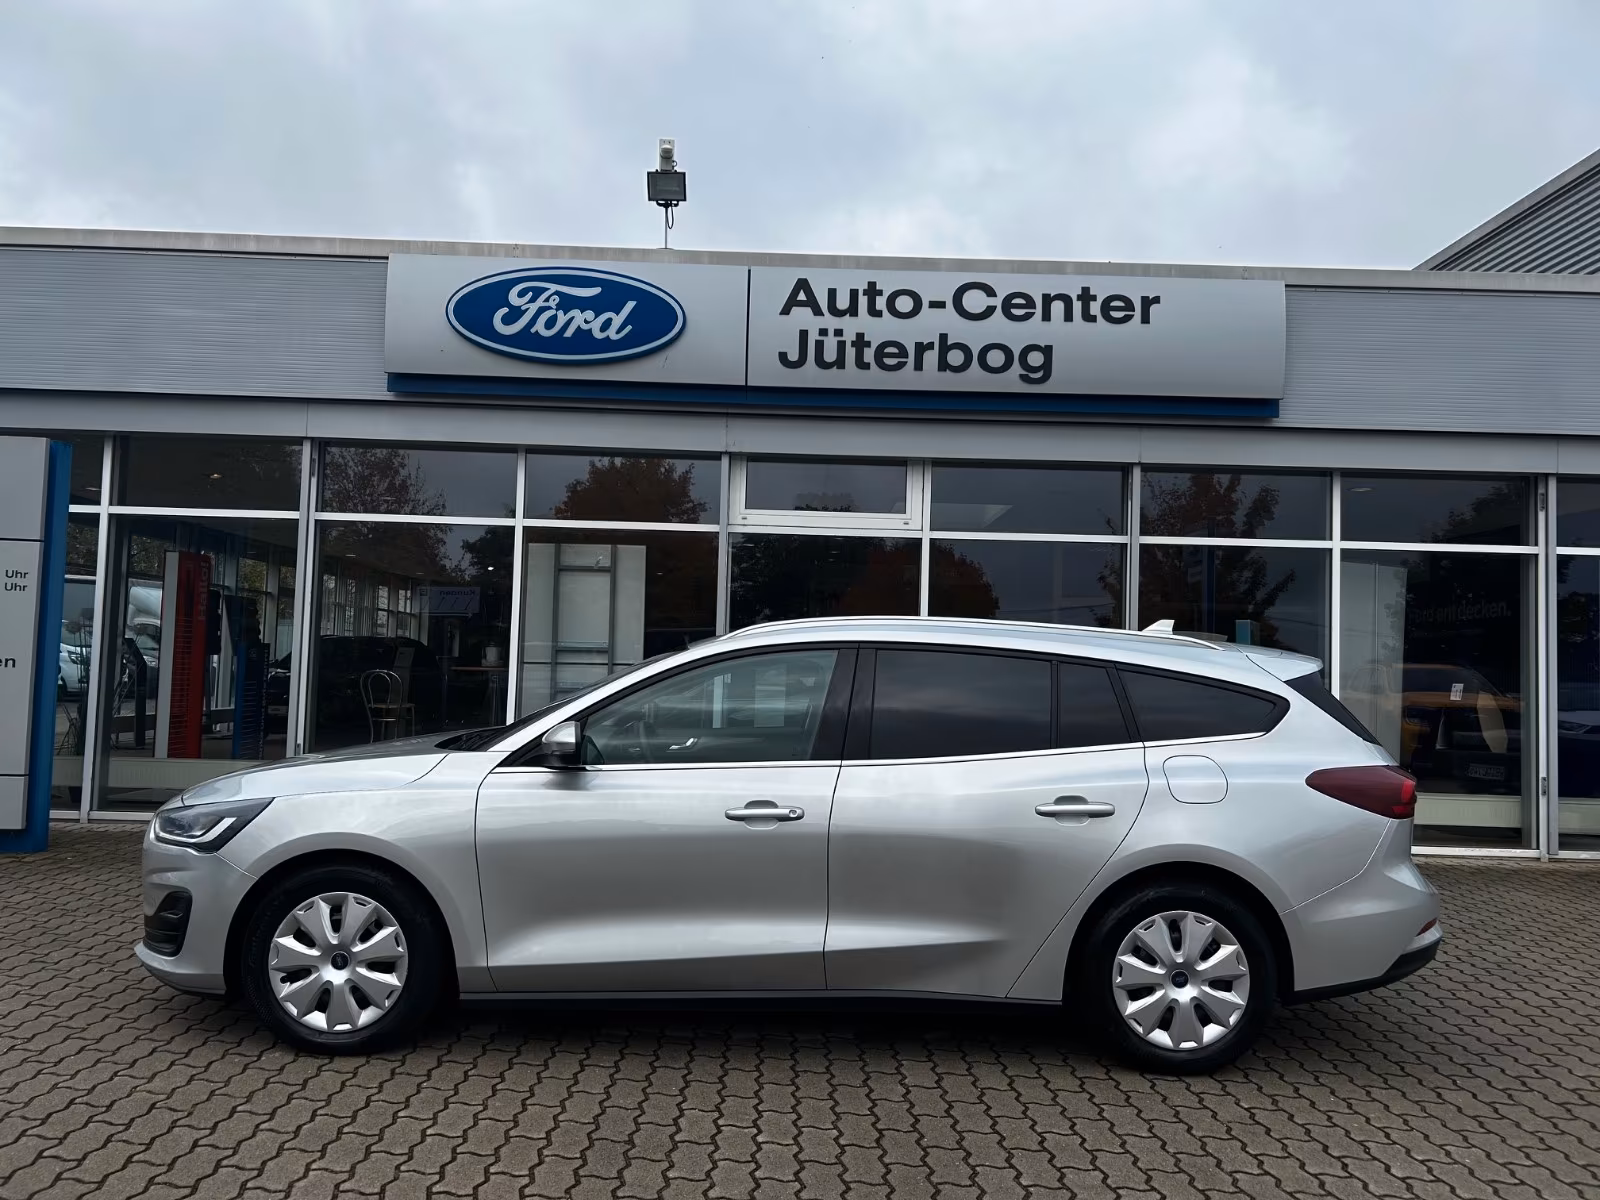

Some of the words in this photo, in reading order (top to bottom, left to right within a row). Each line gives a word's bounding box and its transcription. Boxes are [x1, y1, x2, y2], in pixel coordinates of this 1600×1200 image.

[494, 281, 636, 340] Ford
[779, 277, 1161, 326] Auto-Center
[778, 327, 1054, 383] Jüterbog
[4, 582, 28, 592] Uhr
[5, 569, 29, 579] Uhr
[0, 657, 16, 669] n
